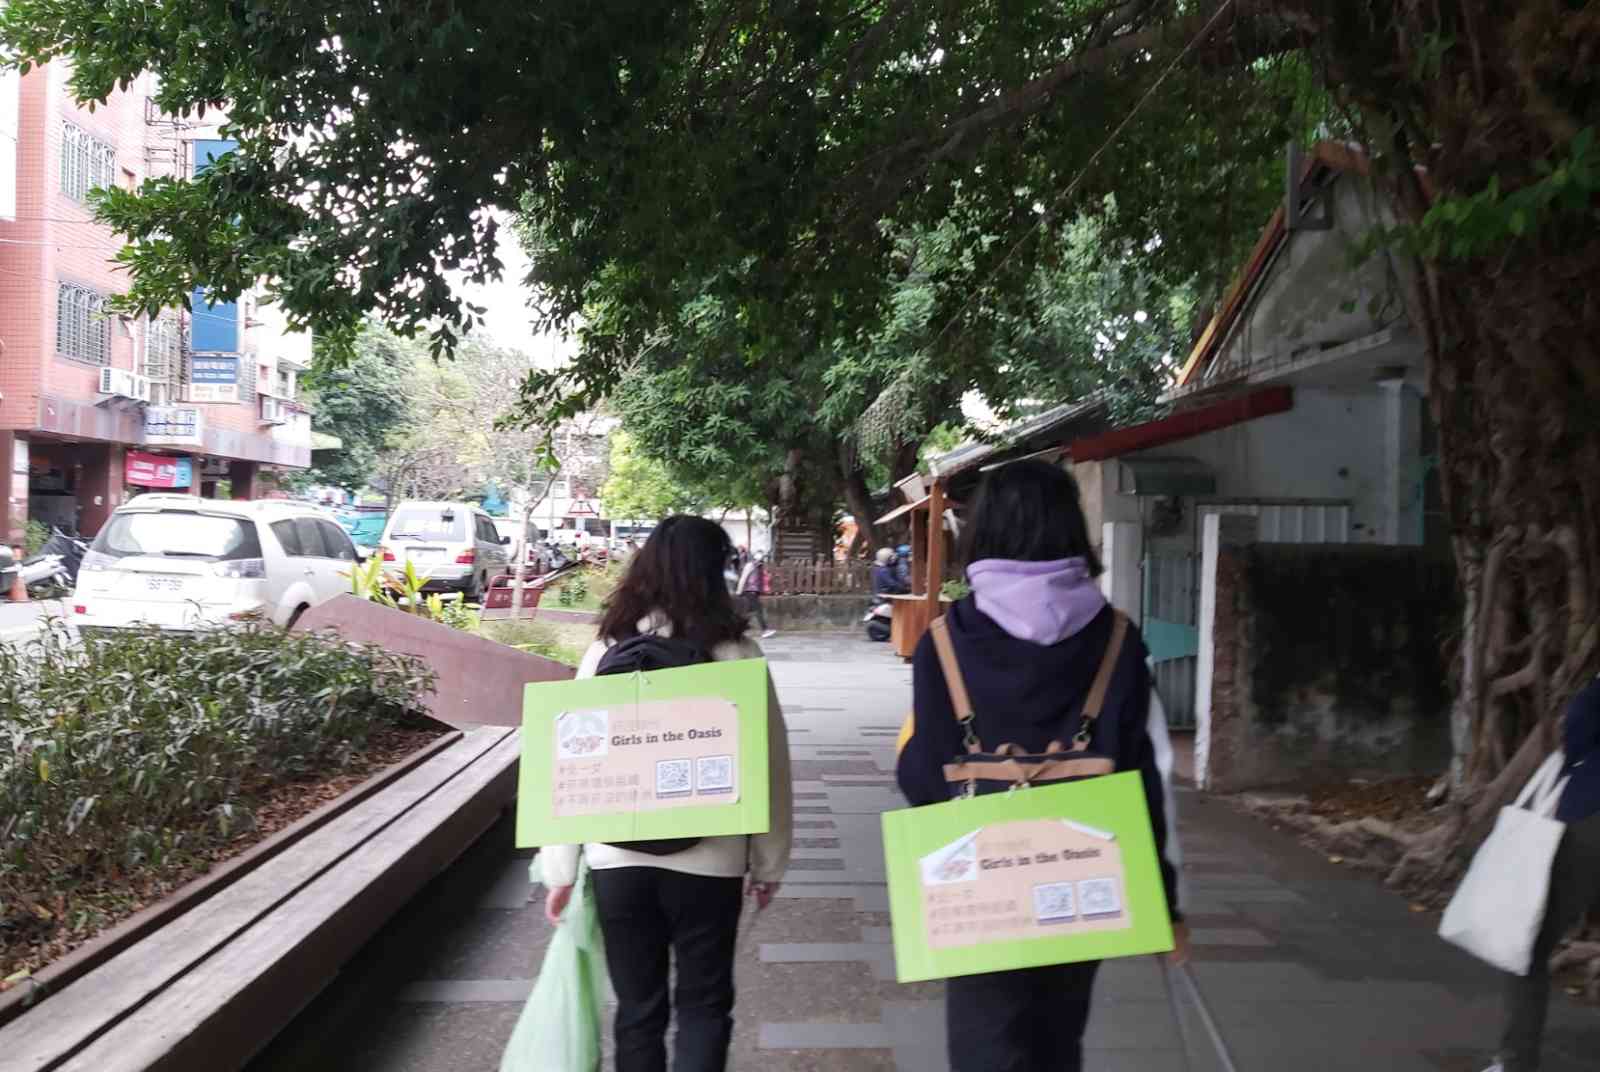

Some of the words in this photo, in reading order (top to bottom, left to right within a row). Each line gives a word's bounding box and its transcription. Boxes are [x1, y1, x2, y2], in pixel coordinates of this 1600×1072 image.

[611, 734, 642, 746] Girls
[646, 732, 659, 743] in
[662, 730, 684, 742] the
[688, 726, 722, 740] Oasis
[1035, 852, 1058, 864] the
